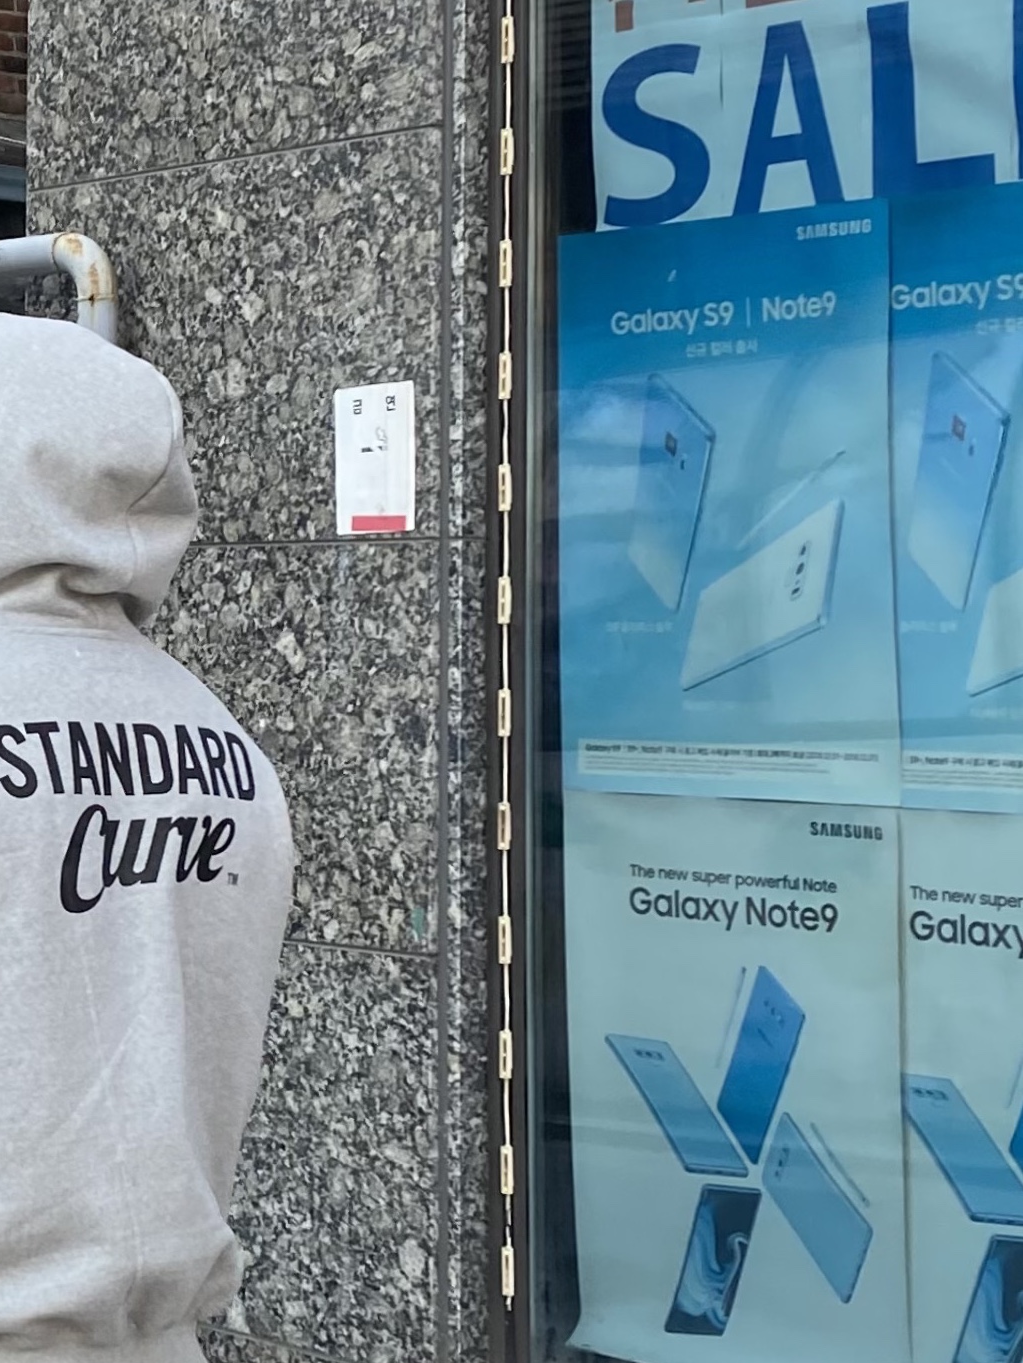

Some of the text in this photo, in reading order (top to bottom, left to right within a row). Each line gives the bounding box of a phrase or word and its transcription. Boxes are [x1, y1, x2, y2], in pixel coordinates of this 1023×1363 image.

[602, 0, 1023, 227] SAL
[796, 218, 872, 241] SAMSUNG
[890, 280, 992, 311] Galaxy
[610, 291, 837, 336] Galaxy S9 Note9
[809, 821, 883, 841] SAMSUNG
[59, 804, 236, 914] Curve
[629, 863, 838, 893] The new super powerful Note
[629, 886, 839, 933] Galaxy Note9
[909, 885, 1023, 912] The new super
